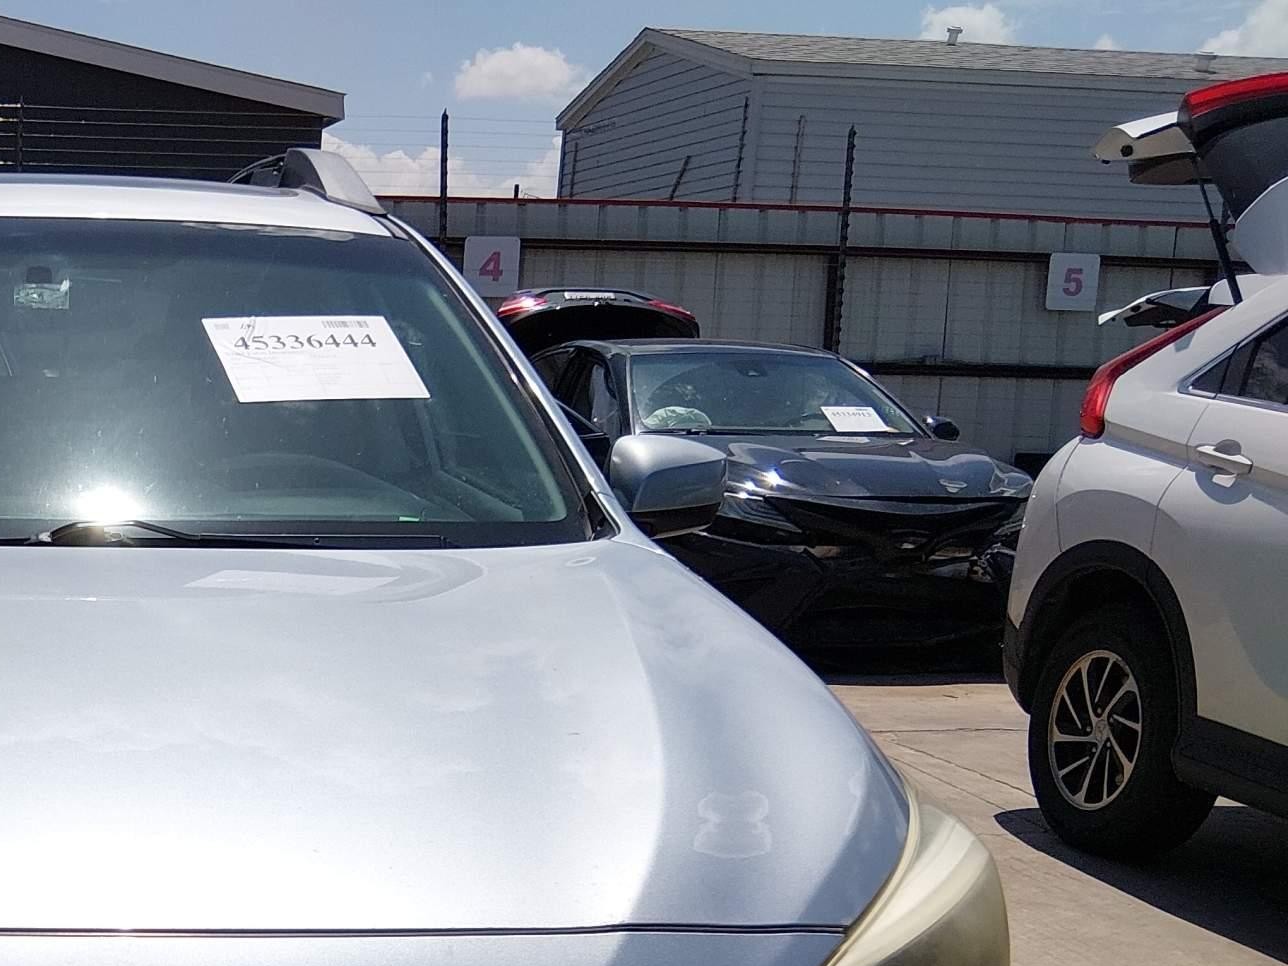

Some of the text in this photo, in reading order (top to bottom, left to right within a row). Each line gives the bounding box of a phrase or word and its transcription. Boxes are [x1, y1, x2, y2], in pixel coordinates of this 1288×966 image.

[478, 250, 503, 282] 4
[1062, 267, 1083, 297] 5
[233, 333, 377, 351] 45336444
